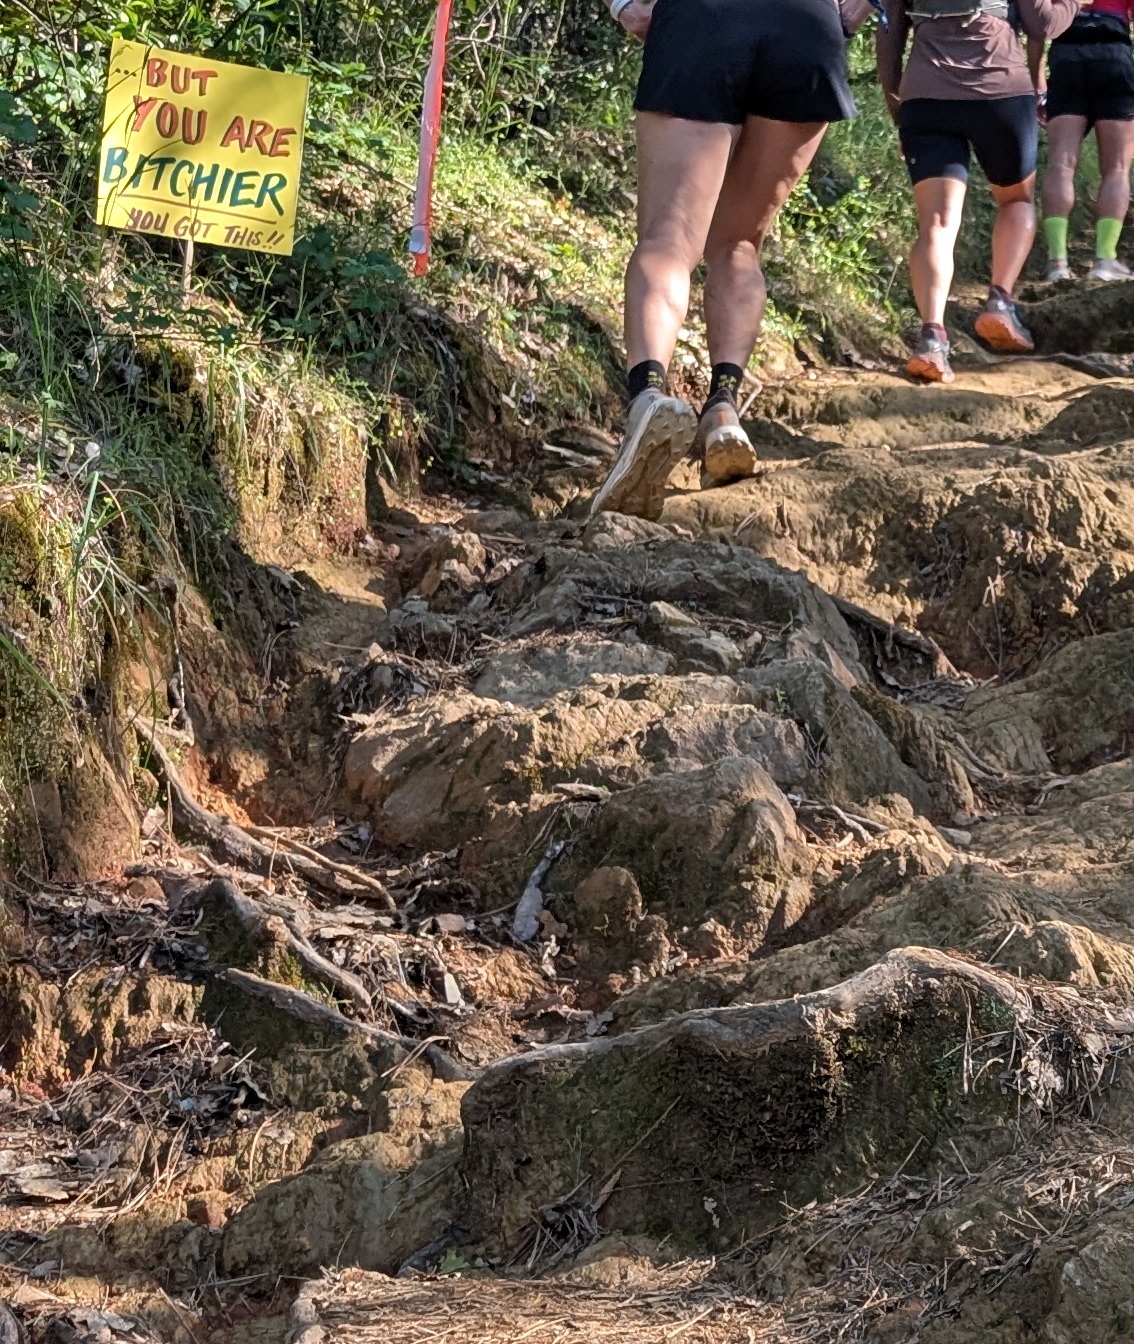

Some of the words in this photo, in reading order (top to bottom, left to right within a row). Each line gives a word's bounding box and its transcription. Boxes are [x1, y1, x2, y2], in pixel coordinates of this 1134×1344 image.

[132, 95, 208, 145] YOU
[220, 115, 297, 157] ARE
[102, 147, 288, 216] BITCHIER
[125, 207, 170, 234] YOU
[173, 216, 219, 239] GOT
[223, 225, 285, 249] THIS!!
